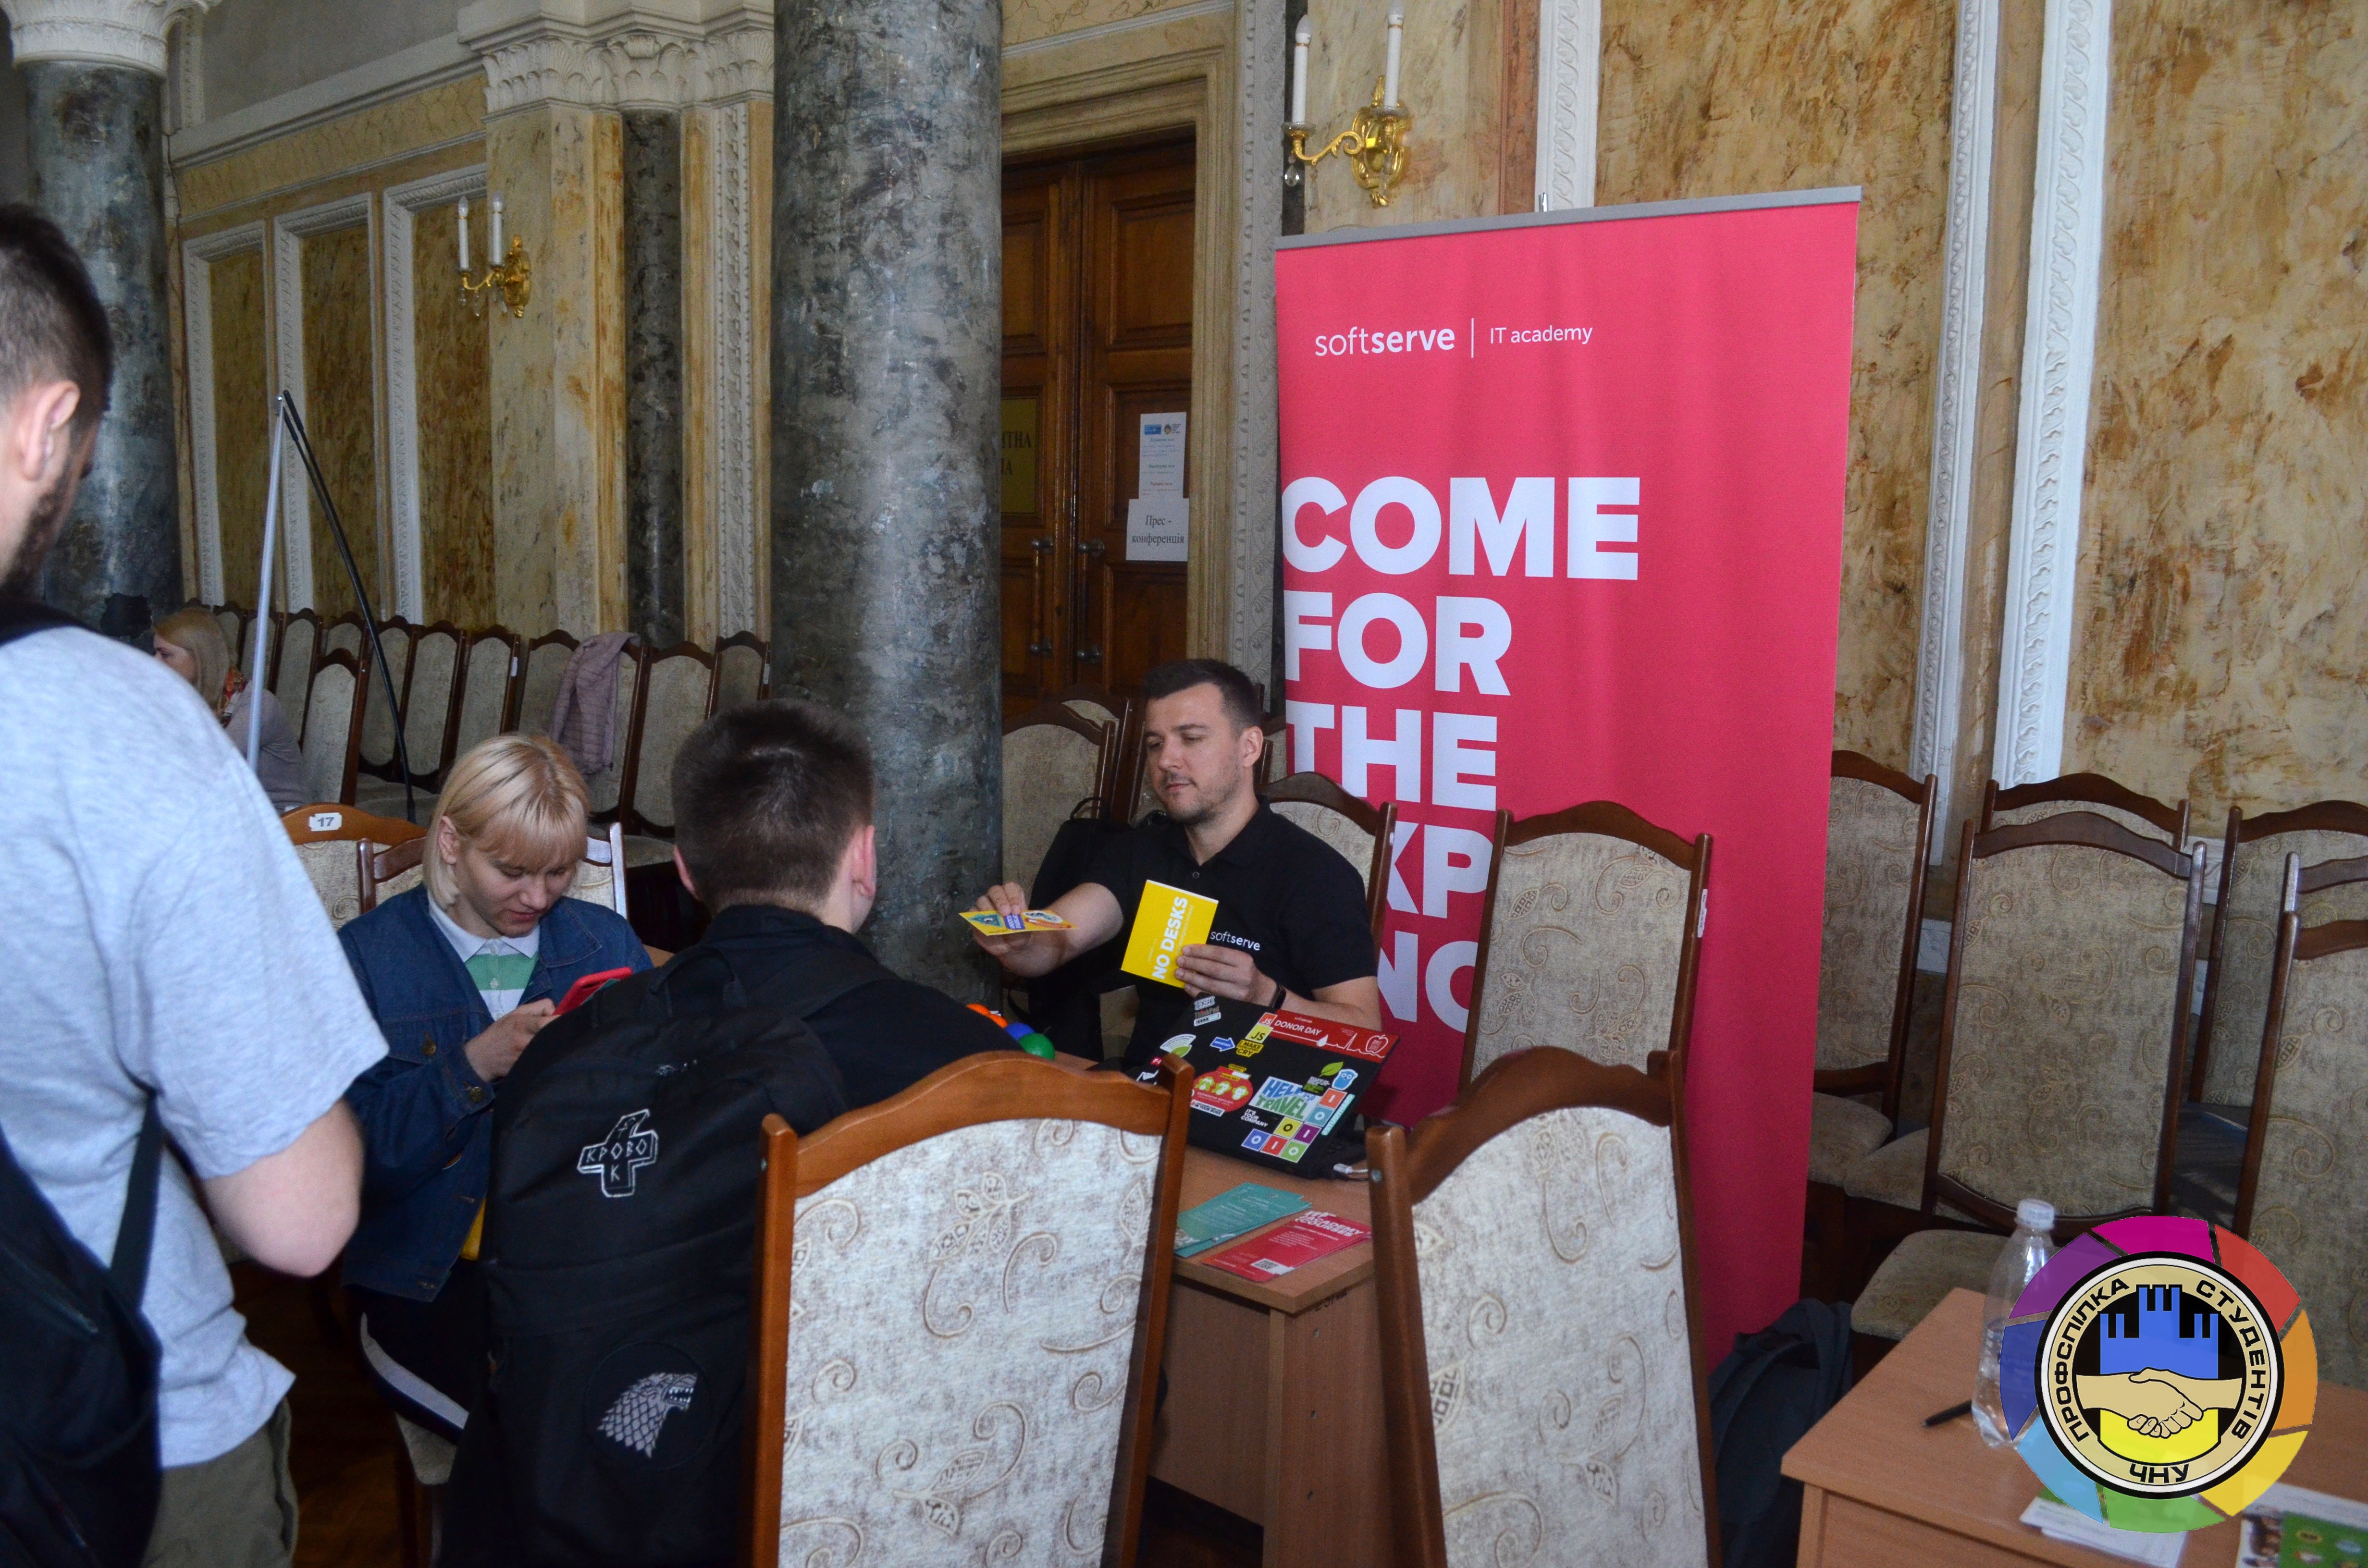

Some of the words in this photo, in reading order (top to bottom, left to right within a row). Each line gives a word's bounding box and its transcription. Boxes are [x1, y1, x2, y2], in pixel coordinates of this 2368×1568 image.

[1315, 327, 1455, 356] softserve
[1490, 327, 1506, 344] IT
[1511, 325, 1593, 344] academy
[1145, 515, 1166, 528] Прес
[1282, 477, 1640, 580] COME
[1132, 533, 1184, 546] конференція
[1283, 590, 1512, 696] FOR
[1286, 700, 1497, 811] THE
[318, 817, 334, 827] 17
[1387, 821, 1493, 919] XP
[1160, 896, 1188, 952] DESKS
[1210, 931, 1261, 951] softserve
[1152, 954, 1170, 980] NO
[1251, 1032, 1265, 1041] JS
[1274, 1019, 1304, 1031] DONOR
[1305, 1027, 1322, 1036] DAY
[1255, 1095, 1307, 1119] TRAVEL
[1241, 1115, 1269, 1127] COMPANY
